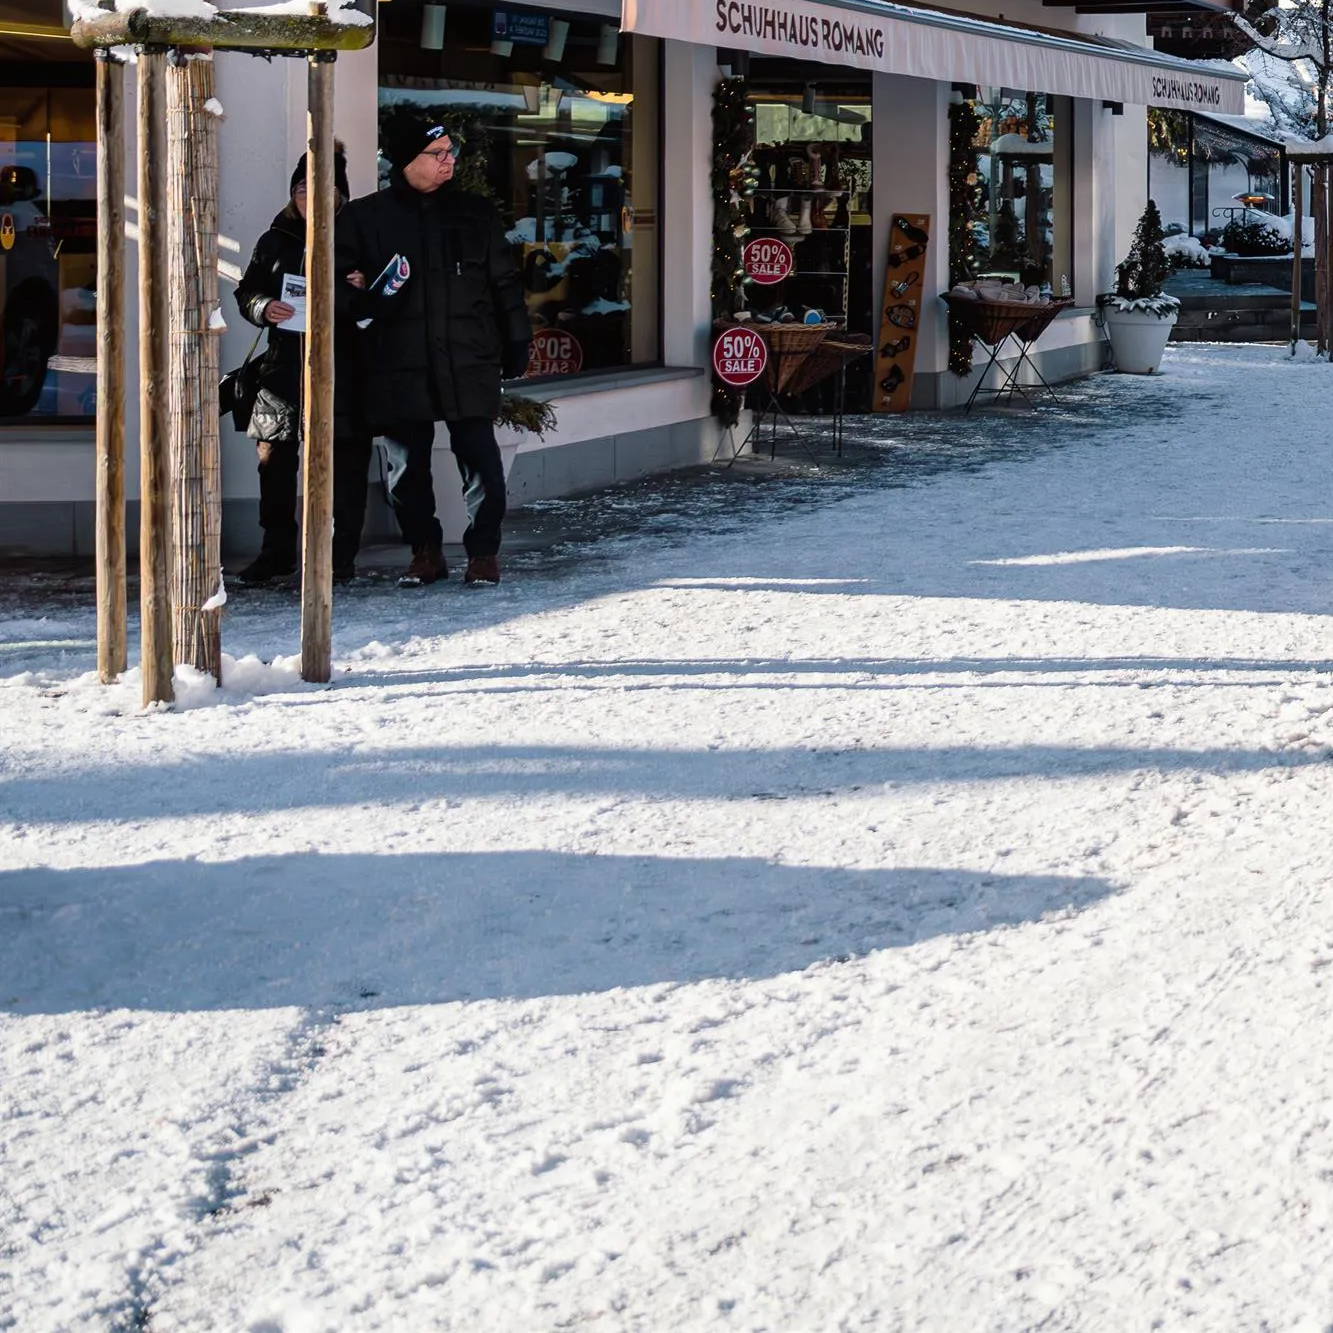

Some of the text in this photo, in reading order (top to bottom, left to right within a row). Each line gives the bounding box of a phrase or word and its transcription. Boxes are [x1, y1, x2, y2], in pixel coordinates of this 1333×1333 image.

[821, 18, 884, 58] ROMANG
[1152, 76, 1220, 106] SCHUHHAUS ROMANG
[751, 244, 786, 263] 50%
[752, 263, 781, 274] SALE
[723, 335, 760, 358] 50%
[725, 360, 755, 372] SALE
